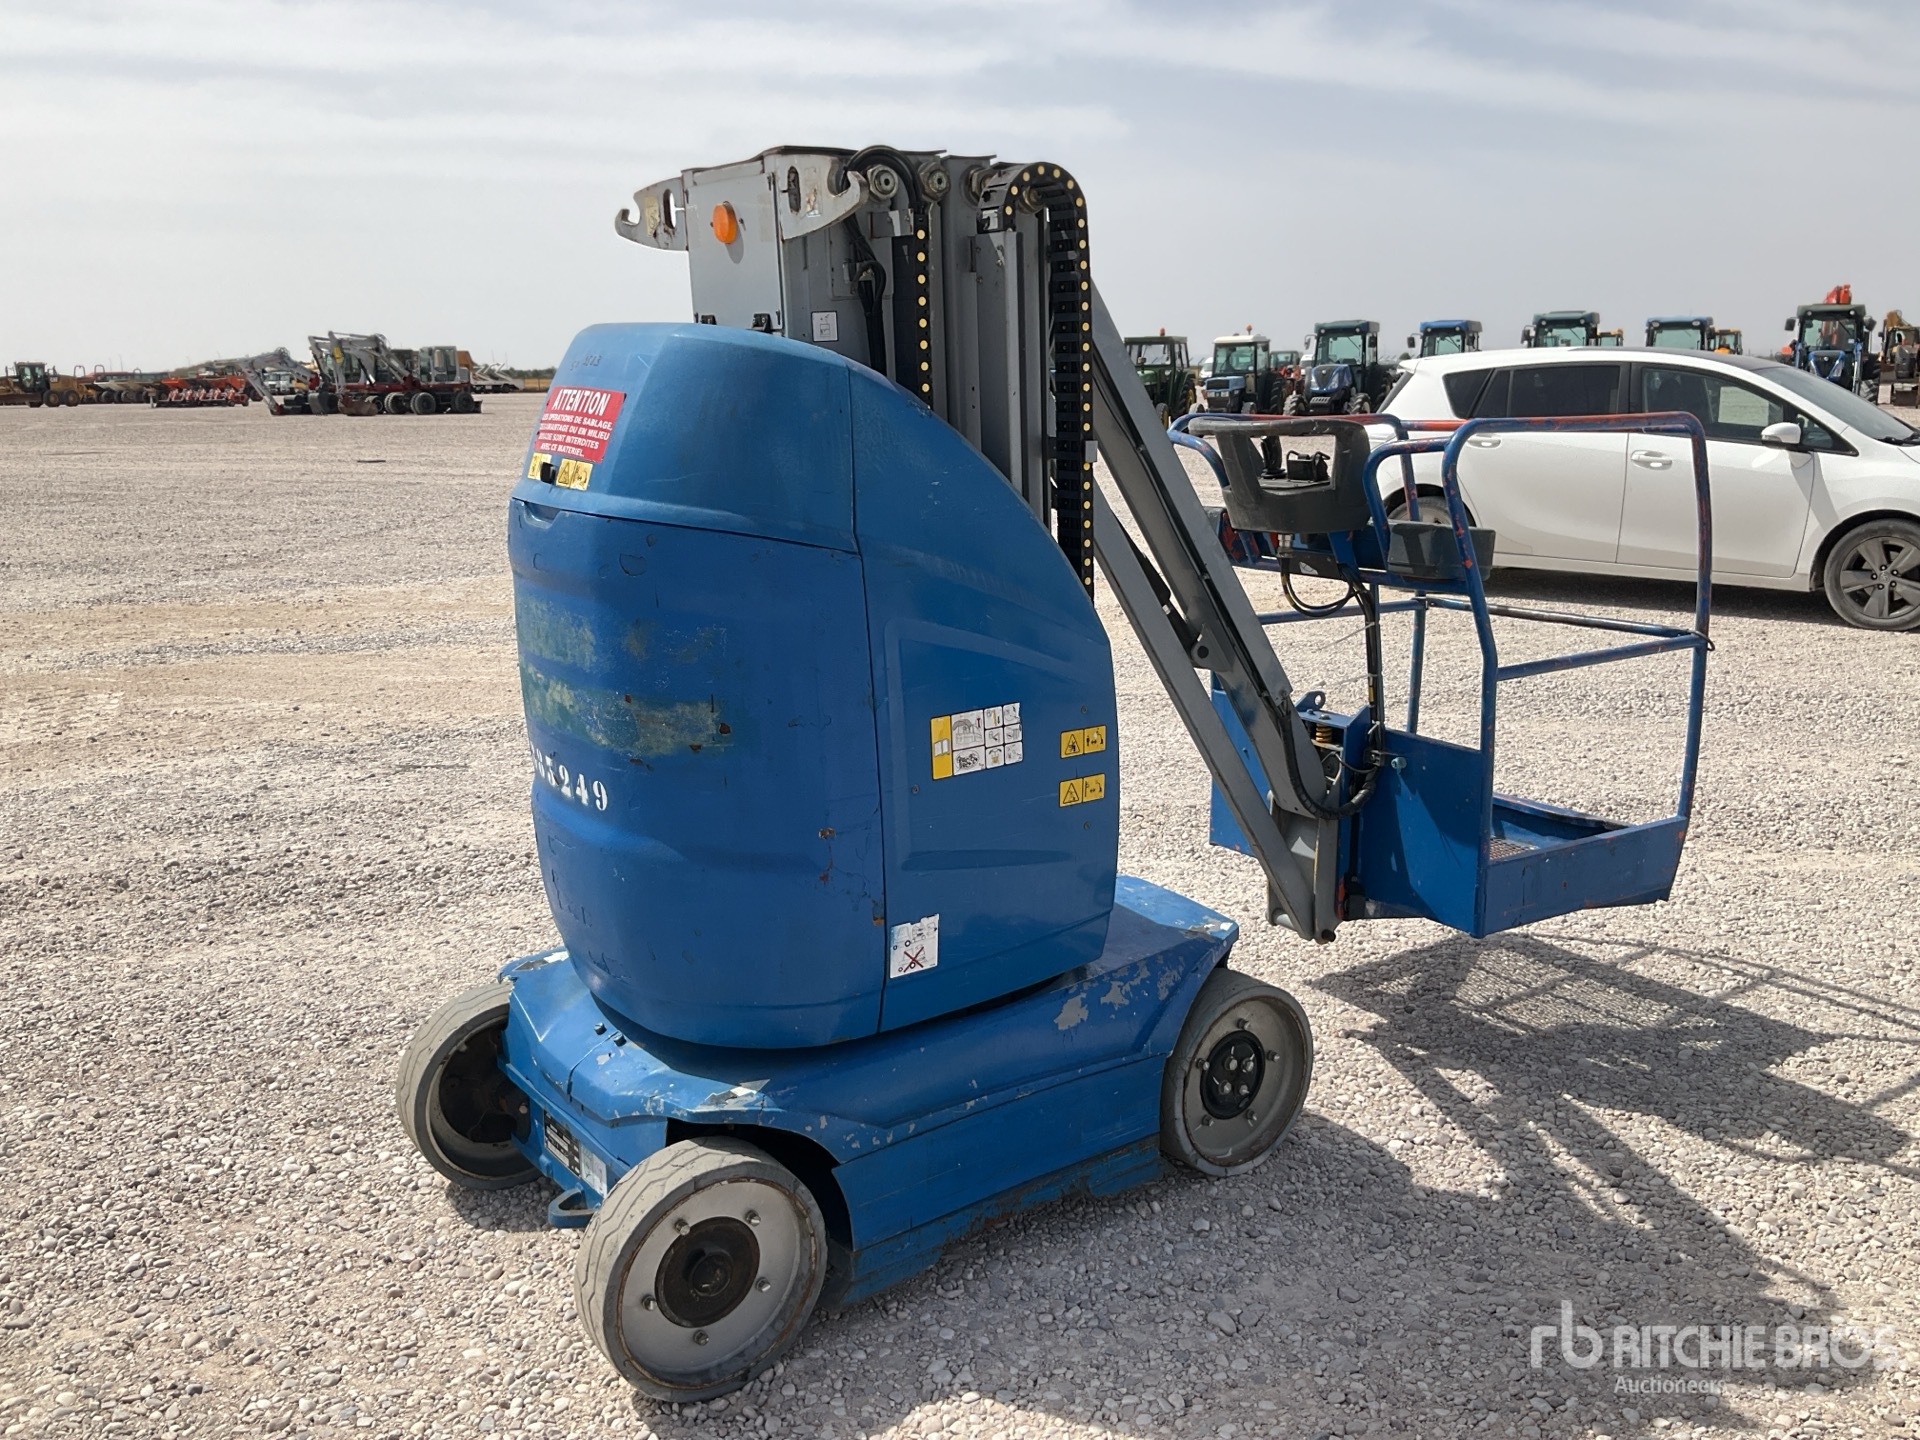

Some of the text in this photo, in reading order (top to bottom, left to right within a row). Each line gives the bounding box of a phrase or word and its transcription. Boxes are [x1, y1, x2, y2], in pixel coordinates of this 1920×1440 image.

[552, 389, 611, 416] ATTENTION
[574, 416, 583, 424] DE
[569, 425, 578, 435] OU
[578, 427, 586, 436] EN
[587, 429, 611, 441] MILIEU
[566, 437, 599, 450] INTERDITES
